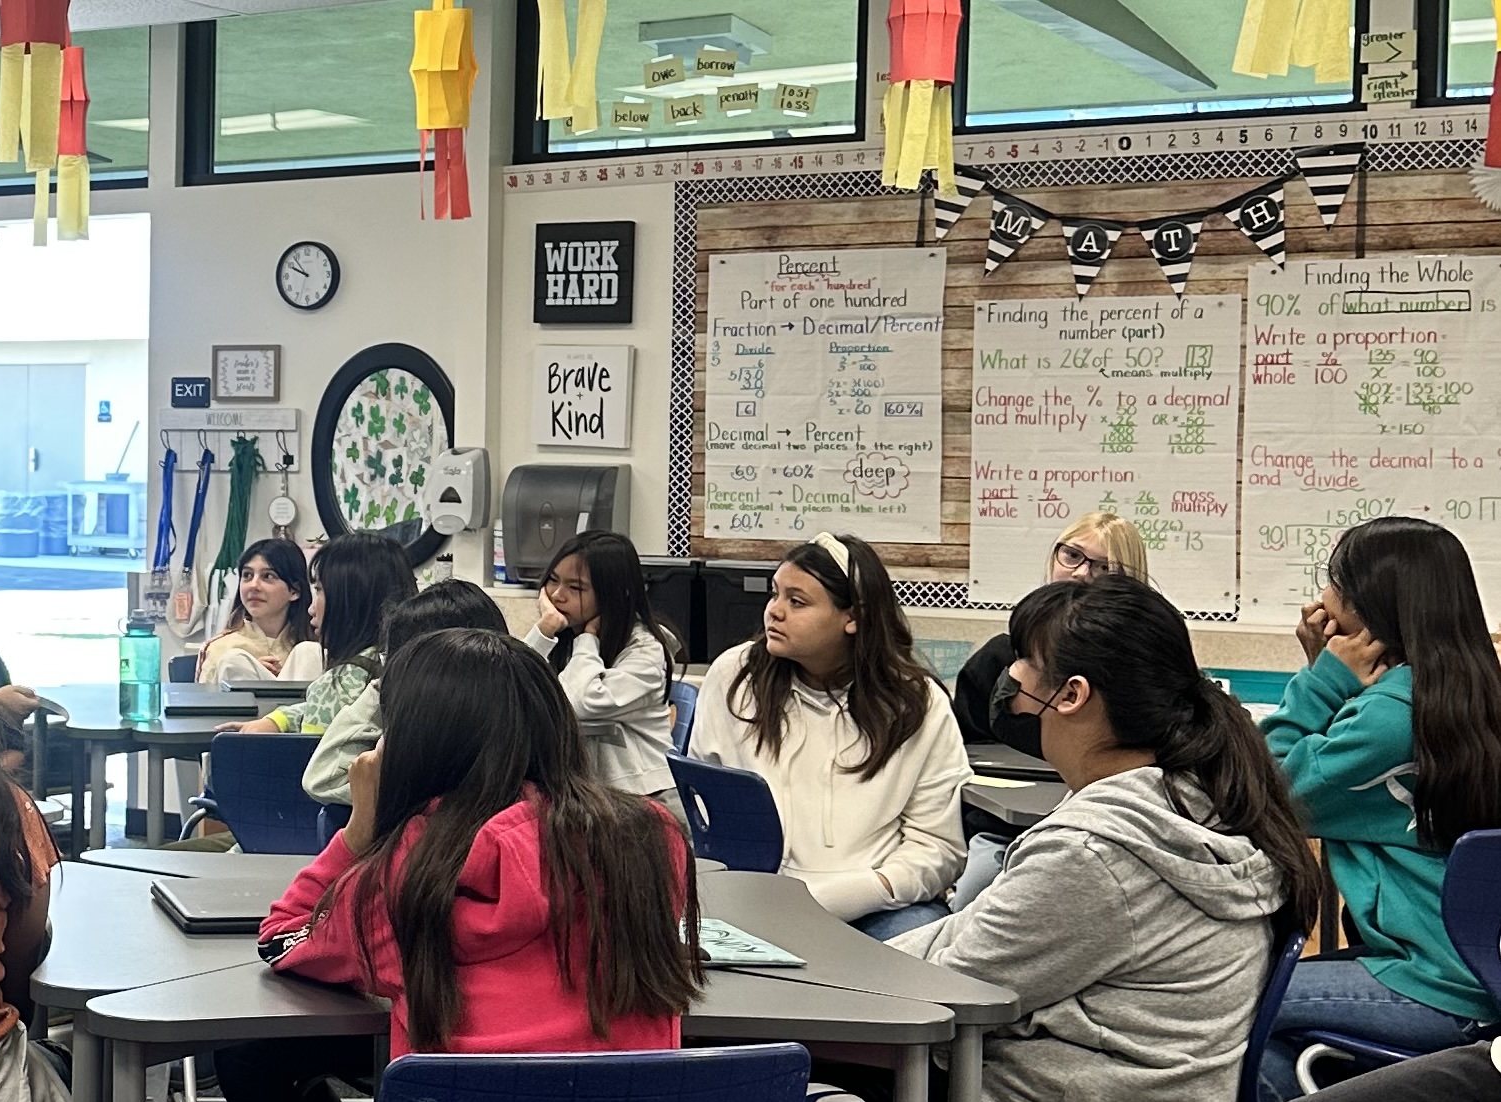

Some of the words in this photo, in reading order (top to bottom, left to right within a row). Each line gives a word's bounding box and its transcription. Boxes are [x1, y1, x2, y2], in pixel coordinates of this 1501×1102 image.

[696, 57, 736, 72] borrow
[614, 107, 650, 123] below
[671, 104, 702, 119] back
[780, 98, 810, 111] loss
[963, 146, 974, 160] -7
[984, 145, 995, 159] -6
[1006, 144, 1018, 158] -5
[1029, 143, 1040, 156] -4
[1051, 140, 1063, 153] -3
[1075, 139, 1086, 153] -2
[1098, 137, 1109, 151] -1
[1118, 136, 1131, 151] 0
[1167, 133, 1177, 147] 2
[1191, 131, 1200, 145] 3
[1216, 130, 1224, 144] 4
[1239, 129, 1248, 144] 5
[1264, 128, 1273, 141] 6
[1290, 126, 1297, 140] 7
[1314, 125, 1323, 139] 8
[1339, 123, 1348, 137] 9
[1362, 124, 1378, 139] 10
[1389, 123, 1401, 136] 11
[1414, 122, 1427, 135] 12
[1441, 120, 1453, 134] 13
[1465, 118, 1478, 132] 14
[544, 240, 619, 272] WORK
[779, 255, 840, 276] Percent
[1304, 263, 1370, 290] Finding
[1377, 261, 1409, 283] the
[1417, 260, 1473, 283] Whole
[545, 272, 619, 305] HARD
[740, 291, 774, 310] Part
[783, 291, 800, 309] of
[810, 296, 835, 309] one
[844, 288, 908, 308] hundred
[987, 303, 1048, 329] Finding
[1060, 302, 1089, 322] the
[1099, 301, 1163, 324] percent
[1170, 298, 1188, 320] of
[1194, 308, 1203, 320] a
[1256, 294, 1301, 317] 90%
[1318, 292, 1343, 316] of
[1346, 293, 1391, 313] what
[1399, 291, 1467, 312] number
[1481, 296, 1497, 312] is
[713, 318, 776, 337] Fraction
[1059, 320, 1117, 340] number
[1121, 322, 1165, 341] (part)
[1254, 324, 1306, 346] Write
[1316, 332, 1327, 345] a
[1333, 328, 1437, 350] proportion
[979, 349, 1028, 370] What
[1038, 353, 1050, 369] is
[1092, 348, 1113, 368] of
[1125, 347, 1164, 369] 50?
[1254, 348, 1293, 366] part
[548, 362, 611, 394] Brave
[1111, 370, 1153, 379] means
[1160, 367, 1212, 381] multiply
[1252, 365, 1295, 384] whole
[1314, 368, 1347, 384] 100
[1417, 366, 1446, 378] 100
[175, 383, 205, 397] EXIT
[975, 386, 1034, 411] Change
[1042, 386, 1072, 406] the
[1086, 385, 1103, 406] %
[1117, 391, 1136, 406] to
[1147, 394, 1157, 406] a
[1164, 385, 1230, 406] decimal
[206, 412, 244, 427] WELCOME
[552, 397, 604, 440] Kind
[975, 406, 1008, 426] and
[1015, 406, 1087, 432] multiply
[708, 423, 769, 442] Decimal
[805, 422, 866, 442] Percent
[814, 441, 848, 454] places
[855, 440, 867, 451] to
[874, 440, 894, 451] the
[1251, 445, 1314, 476] Change
[1328, 447, 1359, 469] the
[1369, 447, 1433, 469] decimal
[1451, 447, 1469, 469] to
[1473, 456, 1483, 469] a
[782, 465, 814, 479] 60%
[852, 458, 895, 486] deep
[975, 460, 1024, 481] Write
[1028, 469, 1039, 481] a
[1044, 465, 1135, 488] proportion
[1249, 471, 1281, 487] and
[1303, 469, 1360, 488] divide
[707, 483, 760, 502] Percent
[792, 483, 856, 502] Decimal
[980, 486, 1018, 502] part
[1036, 503, 1070, 518] 100
[1173, 490, 1215, 503] cross
[977, 502, 1018, 519] whole
[1171, 501, 1228, 517] multiply
[1185, 531, 1204, 551] 13
[1259, 525, 1283, 545] 90
